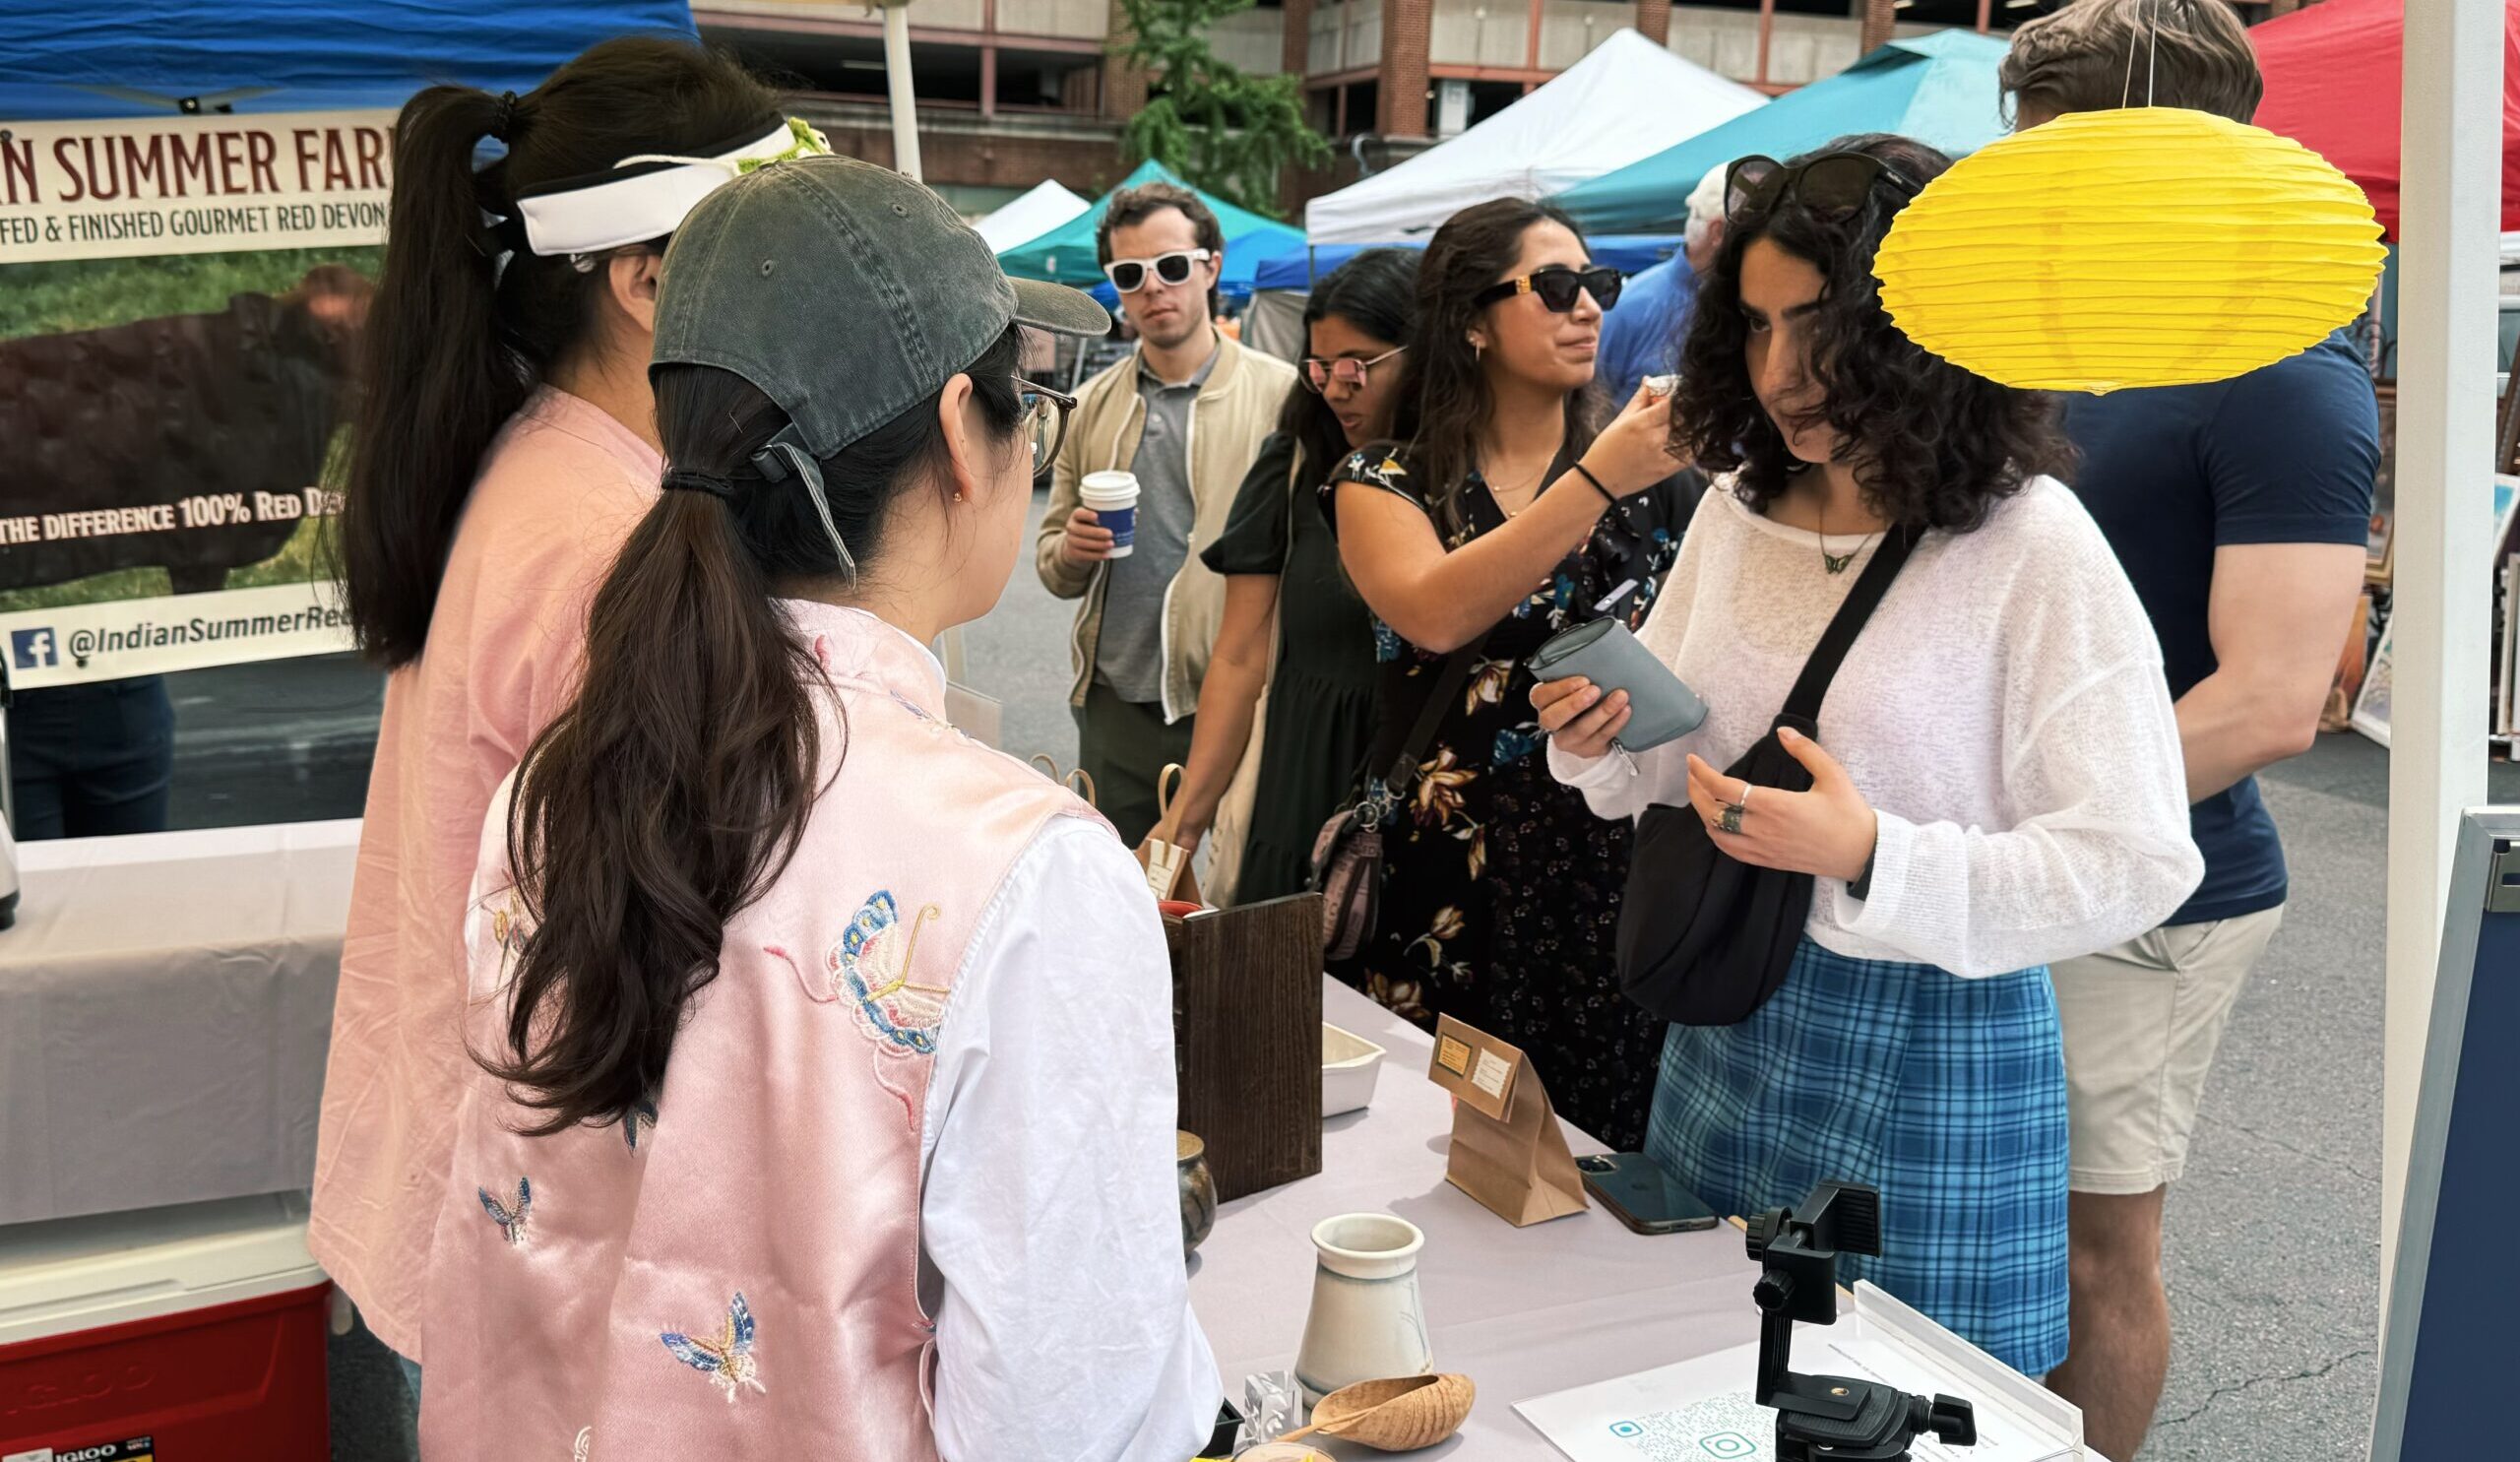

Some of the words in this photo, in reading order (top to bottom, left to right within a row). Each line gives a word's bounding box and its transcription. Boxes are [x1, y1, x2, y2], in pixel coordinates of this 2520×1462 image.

[0, 136, 40, 205] N
[53, 129, 283, 203] SUMMER
[292, 126, 395, 193] FAR
[0, 217, 38, 244] FED
[45, 216, 62, 242] &
[68, 211, 164, 241] FINISHED
[169, 206, 270, 236] GOURMET
[277, 204, 317, 232] RED
[322, 202, 387, 229] DEVON
[0, 515, 40, 545] THE
[42, 503, 176, 540] DIFFERENCE
[178, 492, 252, 529] 100%
